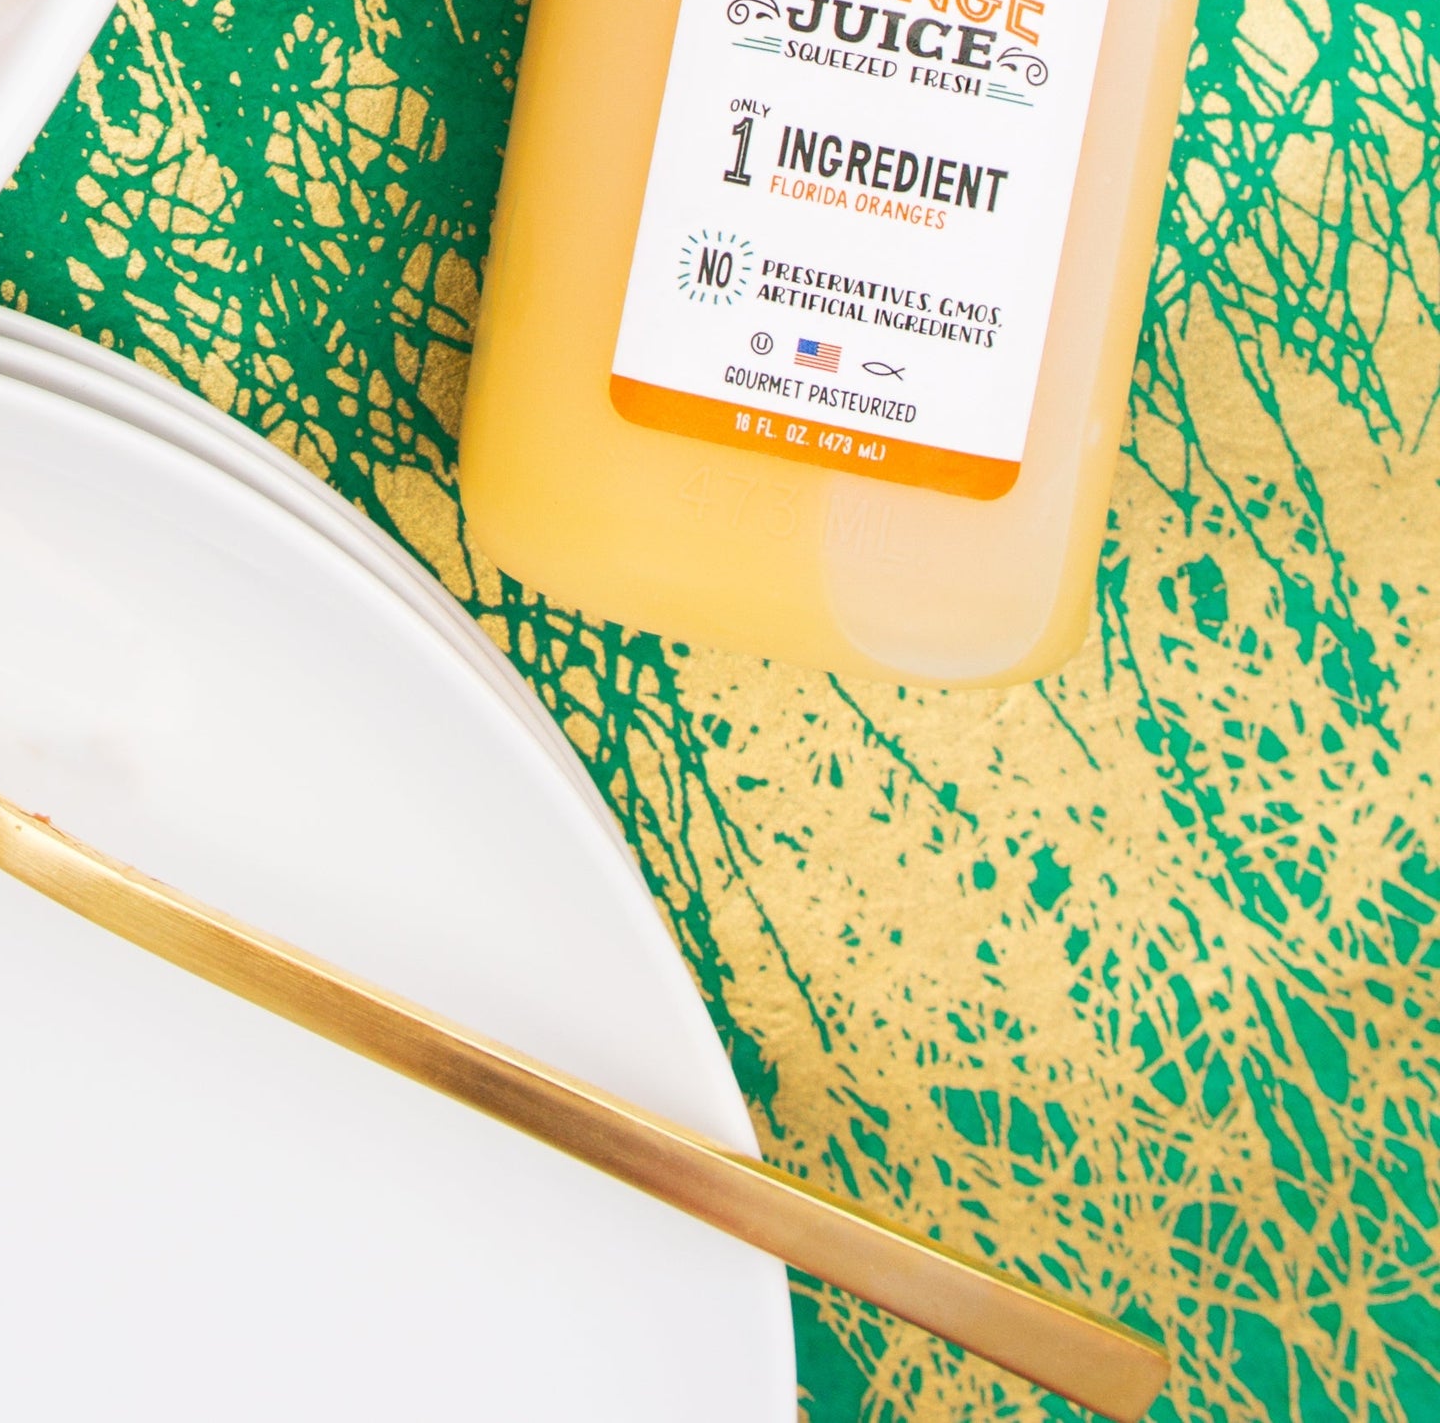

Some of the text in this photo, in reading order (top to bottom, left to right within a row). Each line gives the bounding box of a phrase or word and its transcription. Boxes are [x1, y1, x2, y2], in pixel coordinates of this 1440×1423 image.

[784, 40, 982, 97] SQUEEZED FRESH
[729, 98, 772, 119] ONLY
[722, 116, 1010, 213] 1 INGREDIENT
[769, 174, 948, 231] FLORIDA ORANGES
[697, 246, 734, 289] NO
[756, 283, 997, 349] ARTIFICIAL INGREDIENTS
[724, 365, 918, 424] GOURMET PASTEURIZED
[734, 411, 750, 432] 16
[756, 416, 778, 439] FL.
[785, 424, 810, 447] OZ.
[818, 430, 852, 455] (473
[676, 463, 801, 540] 473
